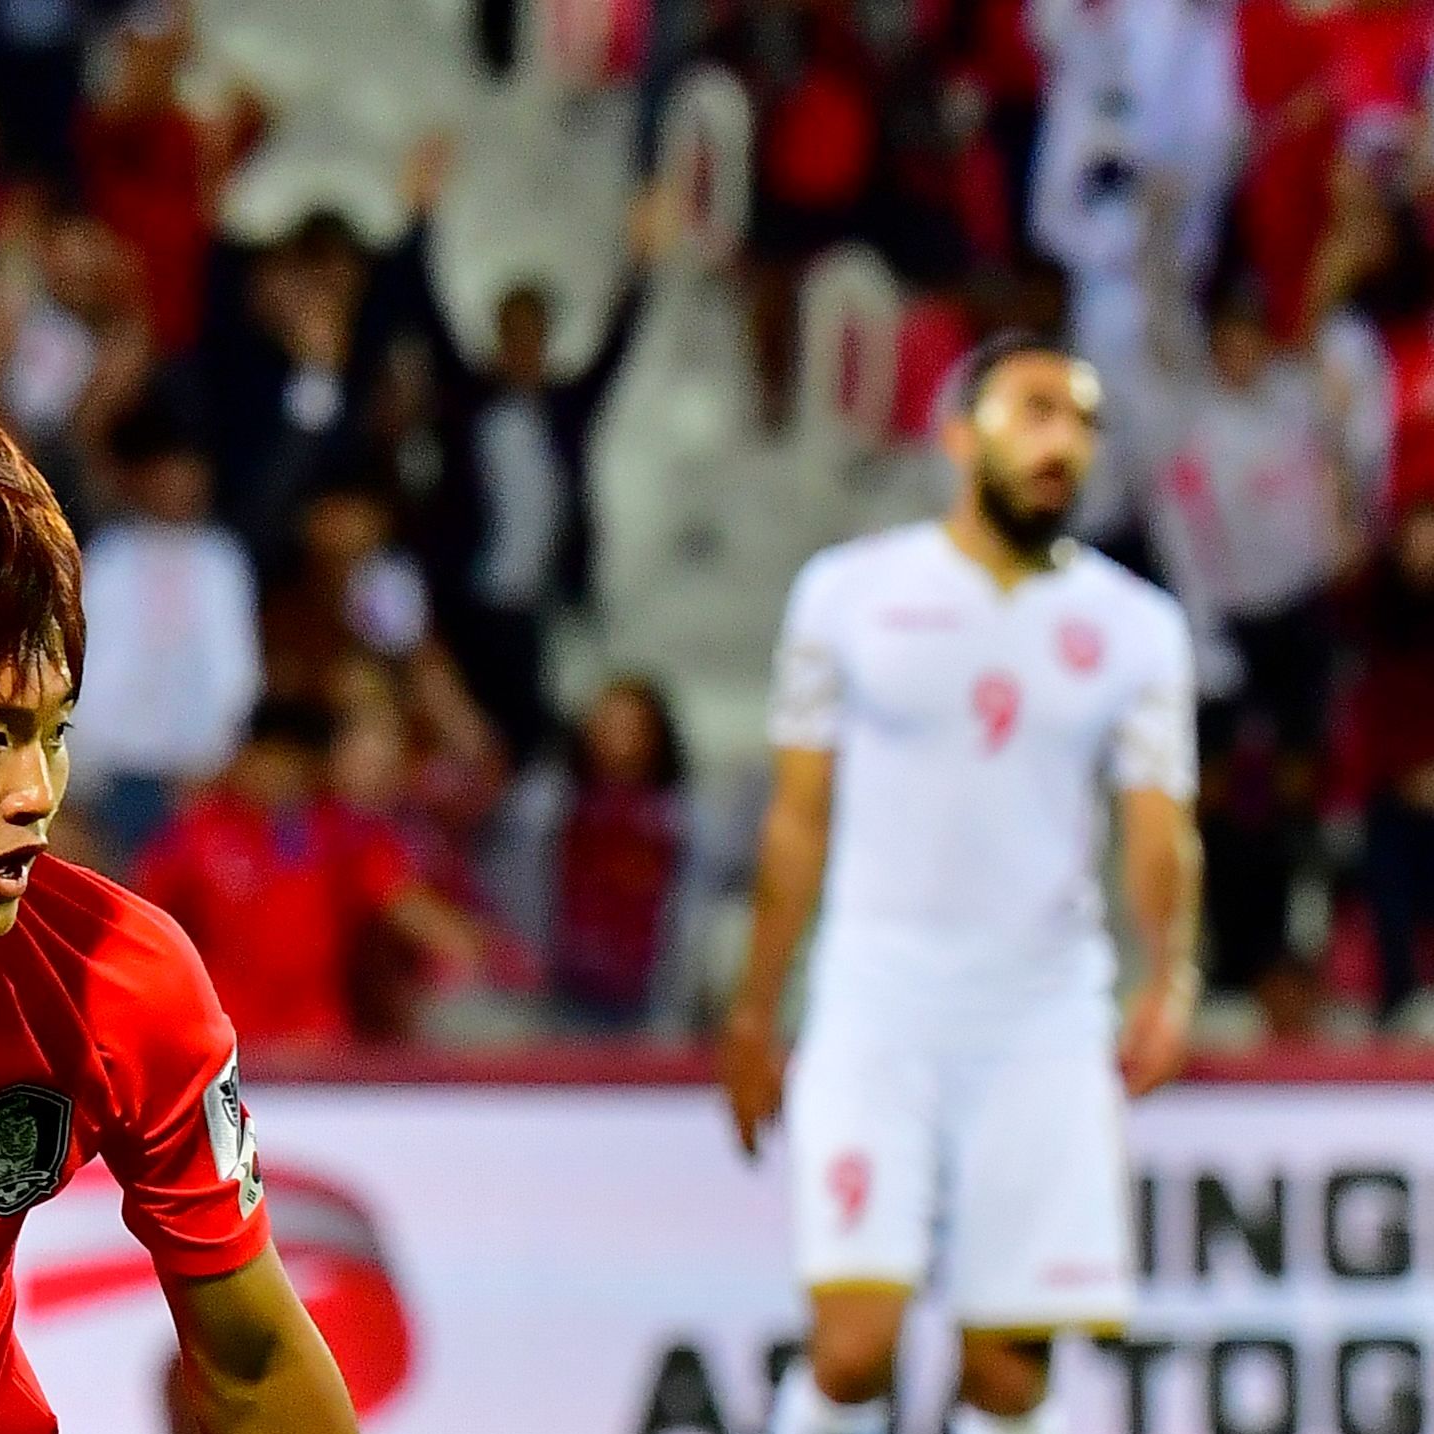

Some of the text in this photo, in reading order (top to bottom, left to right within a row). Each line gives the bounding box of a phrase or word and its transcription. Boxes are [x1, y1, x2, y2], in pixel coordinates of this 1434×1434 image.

[969, 666, 1023, 758] 9
[825, 1152, 875, 1234] 9
[1139, 1170, 1413, 1279] ING
